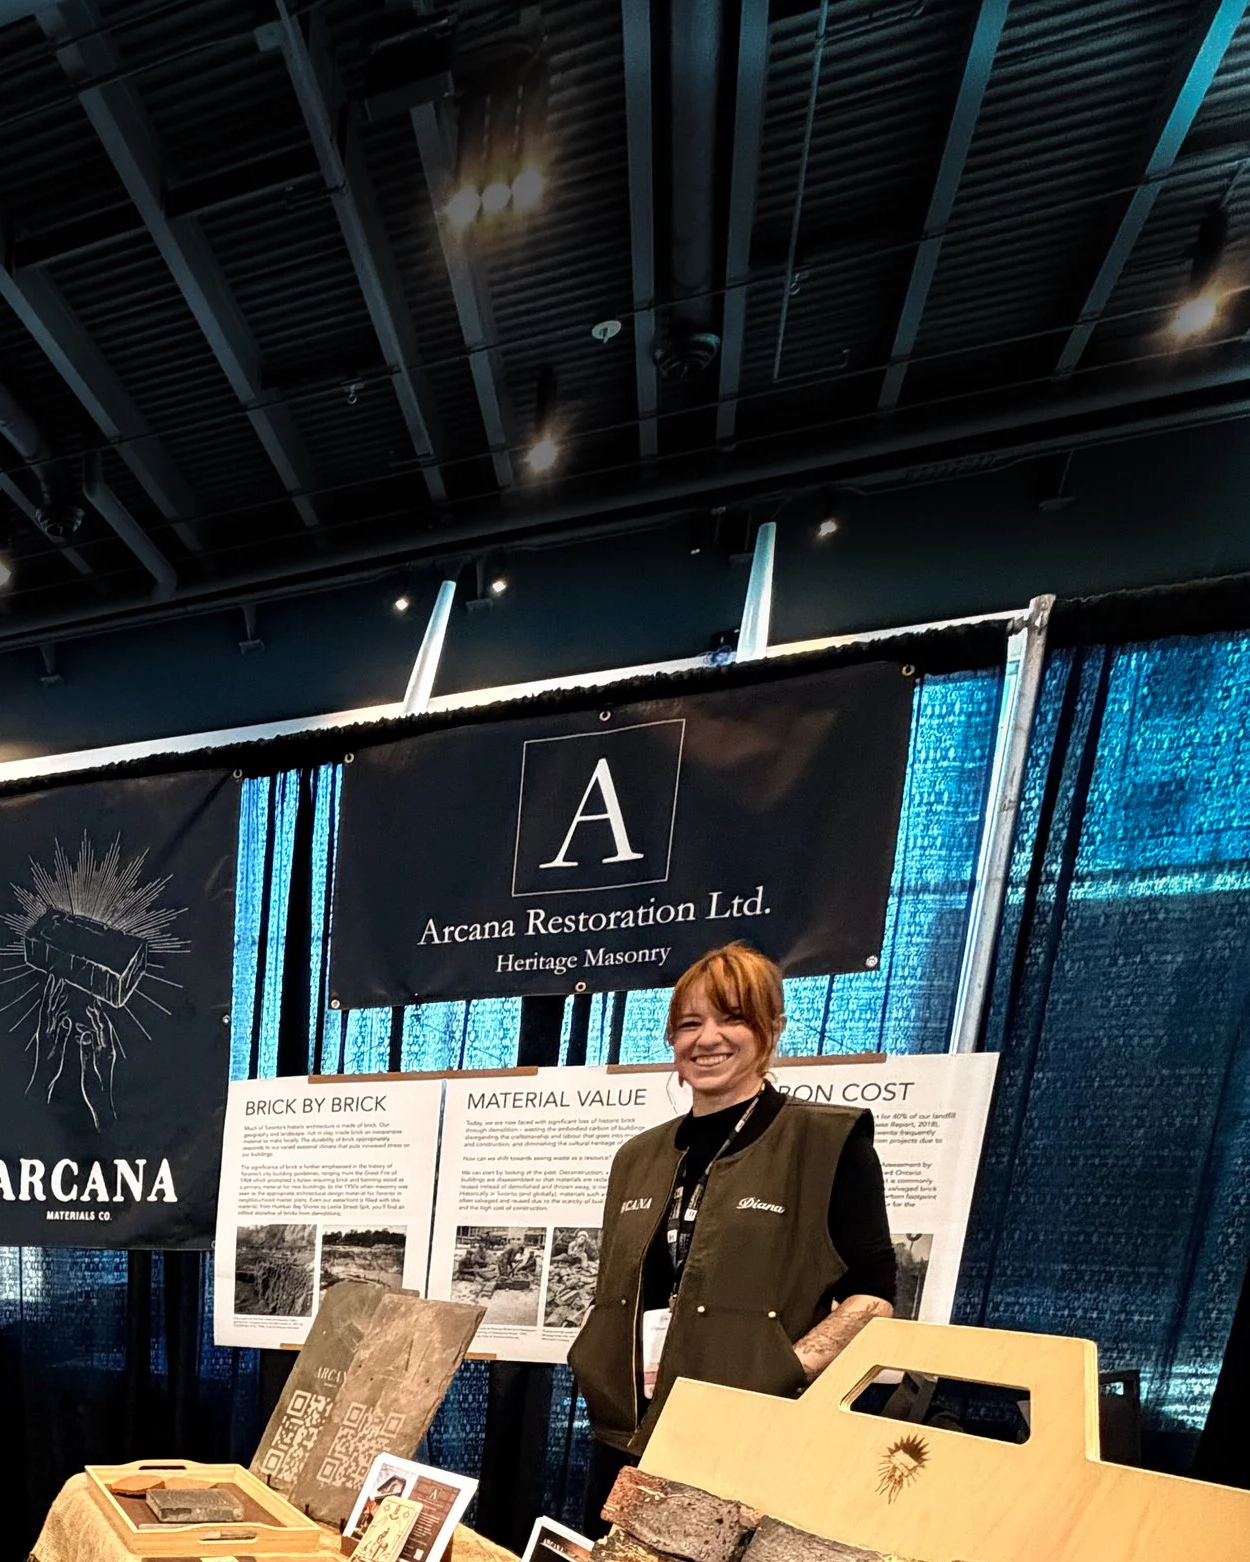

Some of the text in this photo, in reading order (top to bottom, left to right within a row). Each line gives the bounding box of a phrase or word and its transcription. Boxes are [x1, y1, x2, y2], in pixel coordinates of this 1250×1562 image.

[539, 758, 644, 868] A
[417, 886, 771, 946] Arcana Restoration Ltd.
[495, 946, 671, 975] Heritage Masonry
[467, 1088, 647, 1109] MATERIAL VALUE
[842, 1082, 915, 1102] COST
[245, 1095, 387, 1116] BRICK BY BRICK
[46, 1211, 112, 1221] MATERIALS CO.
[736, 1197, 785, 1214] Diana
